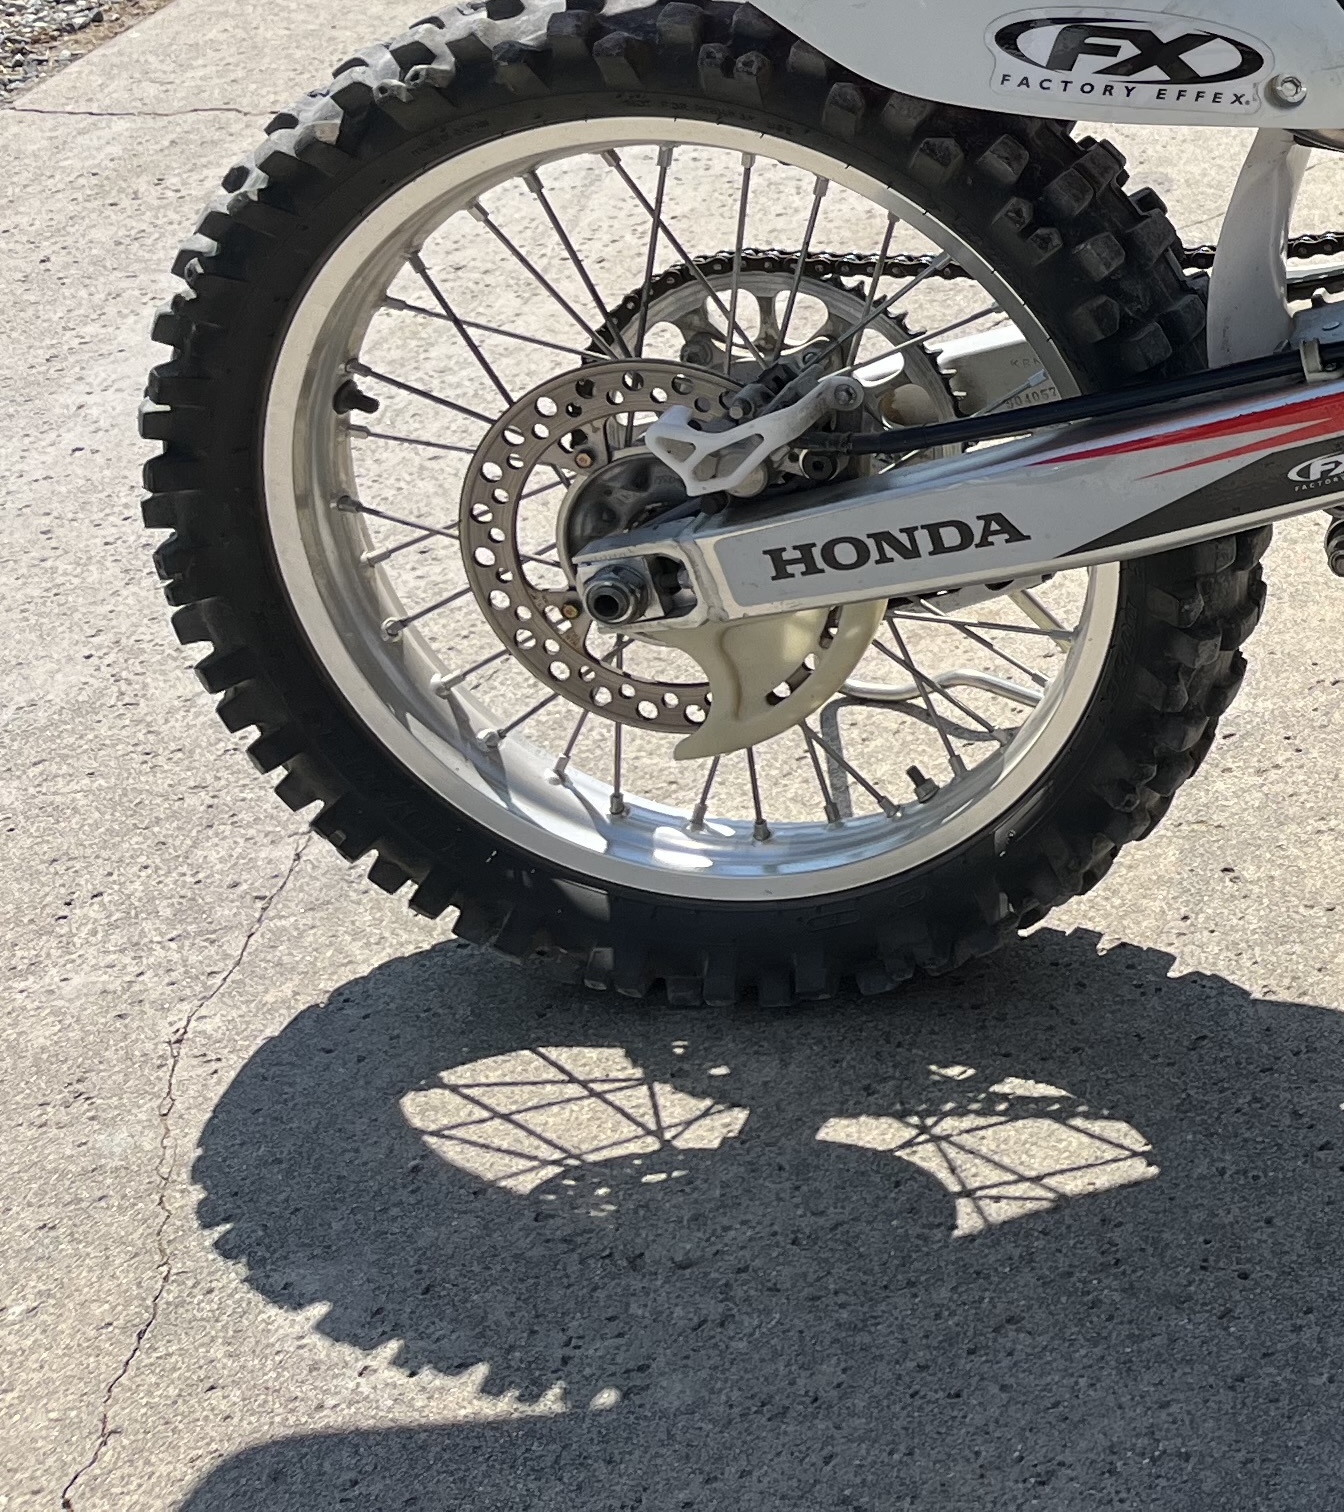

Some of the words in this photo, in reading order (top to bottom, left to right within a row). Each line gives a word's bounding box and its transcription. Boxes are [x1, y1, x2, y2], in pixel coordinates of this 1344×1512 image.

[1045, 23, 1221, 85] FX
[1000, 73, 1137, 99] FACTORY
[1155, 88, 1246, 106] EFFEX
[761, 511, 1031, 583] HONDA
